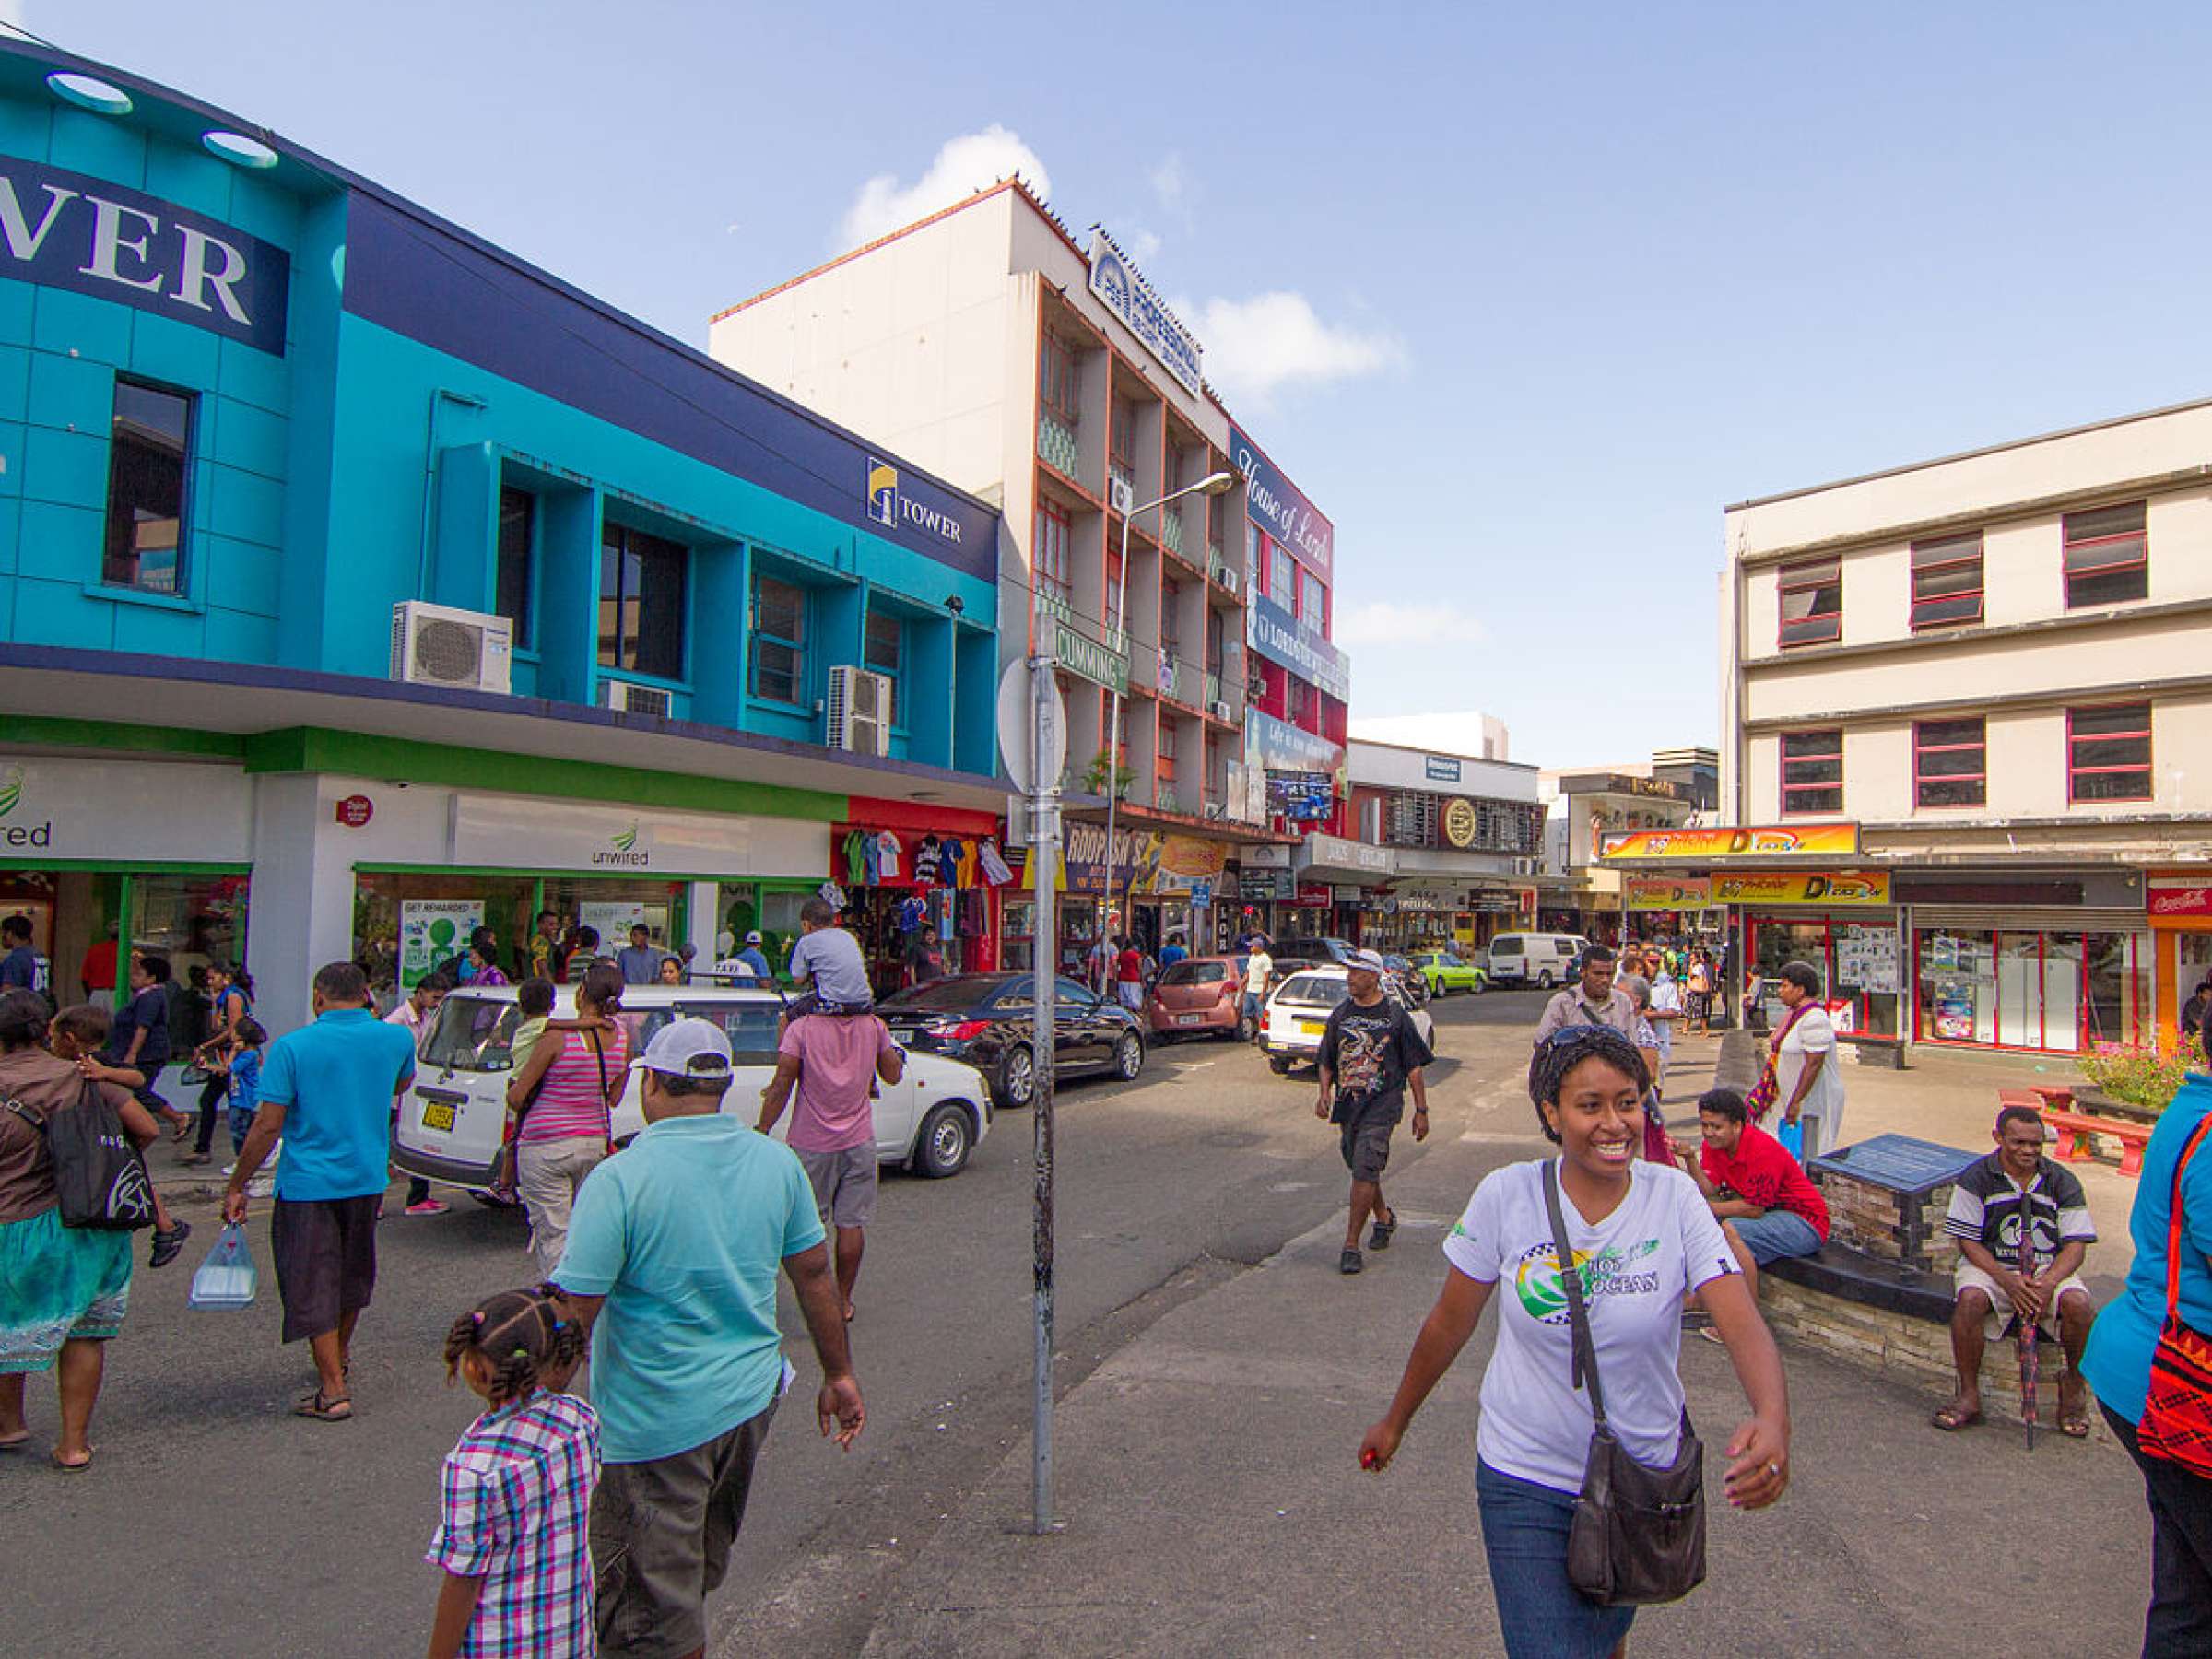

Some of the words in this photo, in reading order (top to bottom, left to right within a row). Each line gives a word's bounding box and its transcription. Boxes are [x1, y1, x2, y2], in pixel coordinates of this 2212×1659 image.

[1239, 449, 1280, 521] House
[1281, 507, 1297, 542] of
[900, 496, 961, 546] TOWER
[0, 821, 51, 847] ed
[593, 850, 649, 865] unwired
[404, 902, 421, 913] GET
[423, 902, 469, 914] REWARDED
